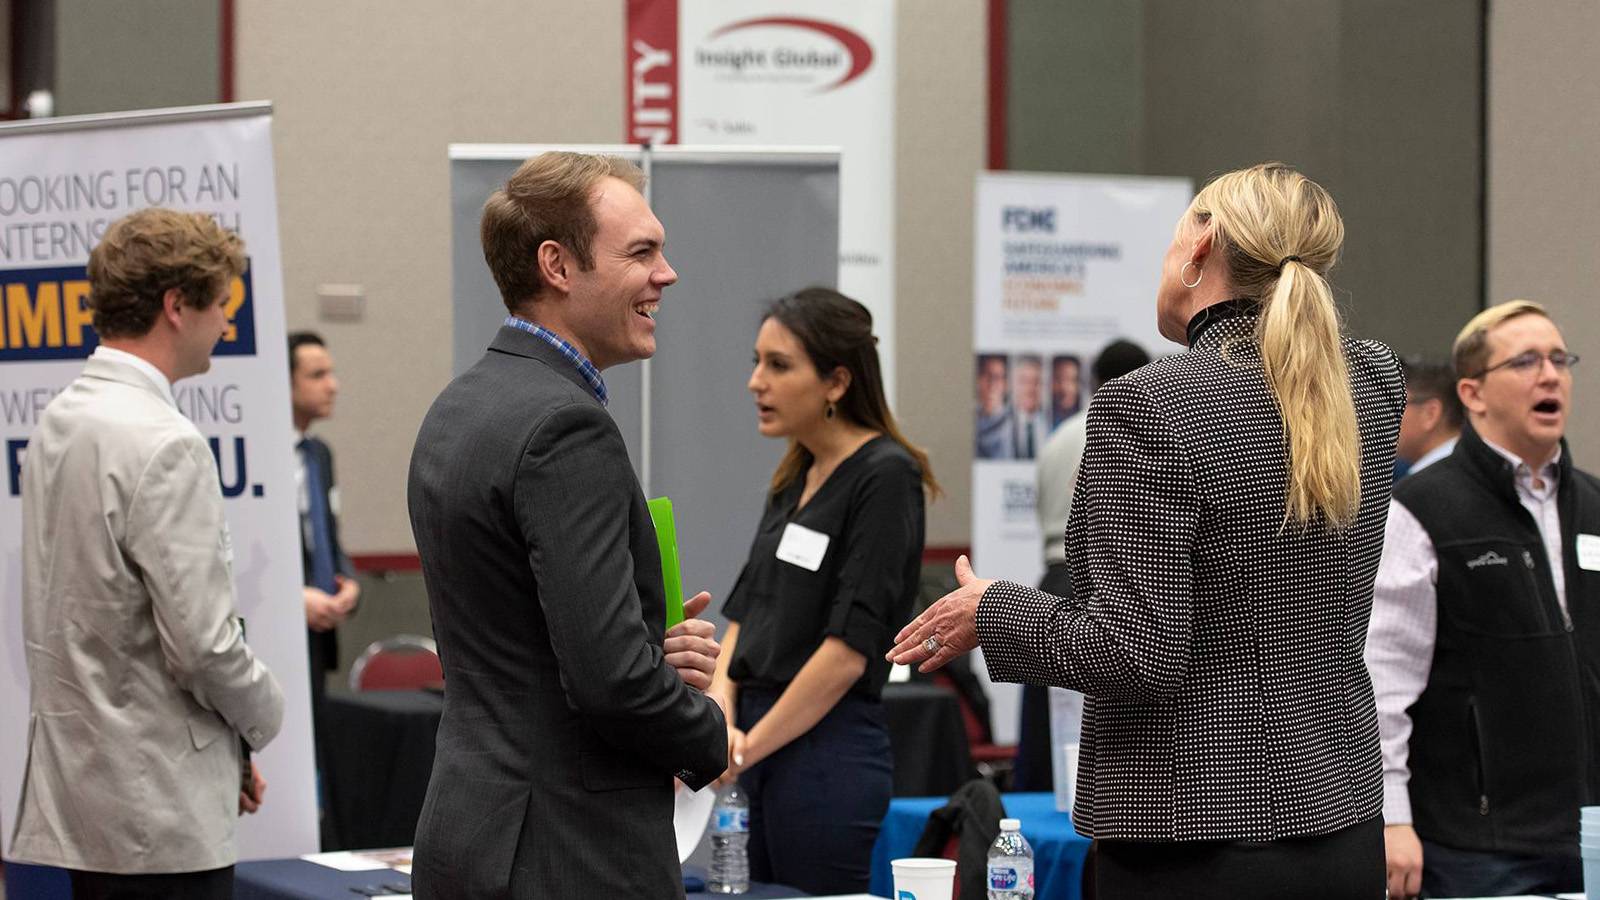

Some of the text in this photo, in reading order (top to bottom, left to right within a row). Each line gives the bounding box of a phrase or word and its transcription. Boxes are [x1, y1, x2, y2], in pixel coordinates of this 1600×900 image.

[695, 47, 842, 69] Insight Global
[633, 38, 672, 145] NITY
[0, 163, 239, 217] OOKING FOR AN
[170, 384, 242, 424] KING
[208, 436, 264, 498] U.
